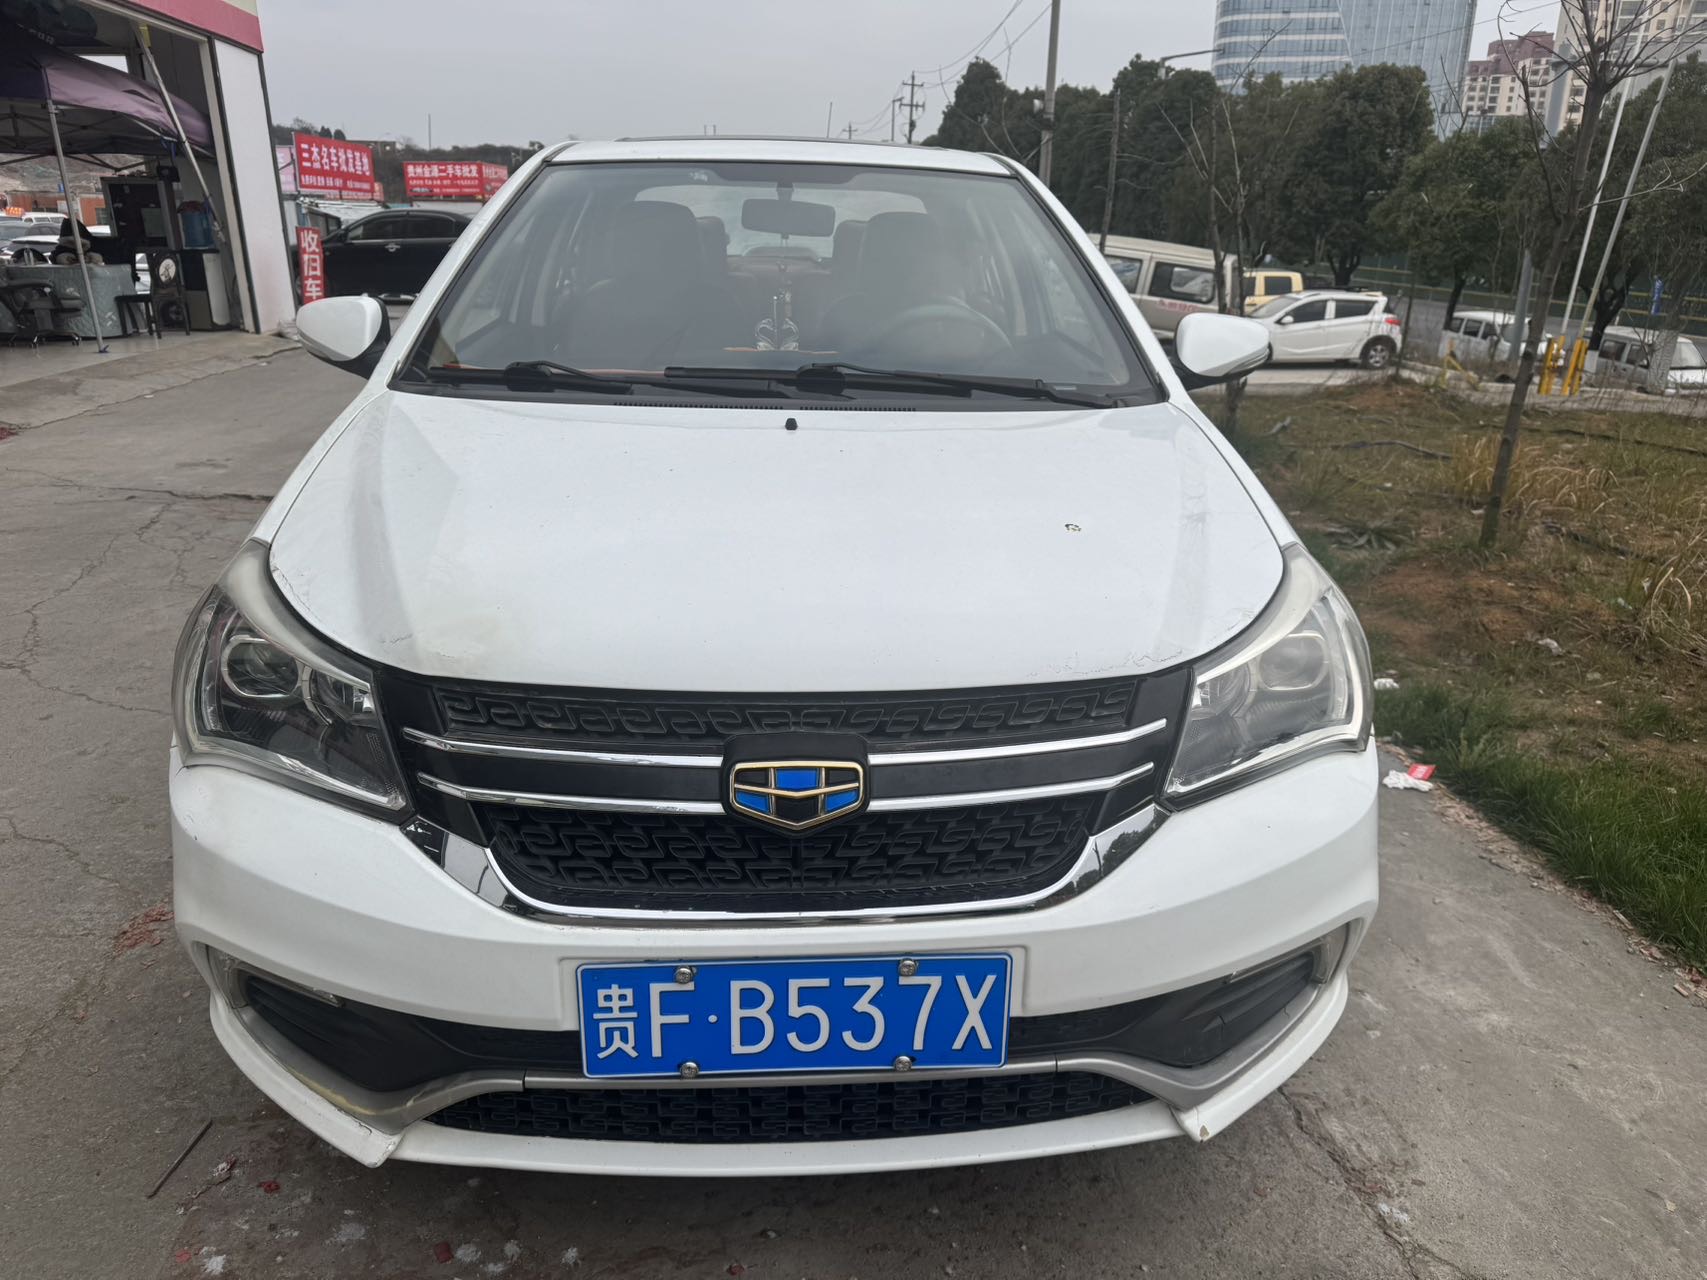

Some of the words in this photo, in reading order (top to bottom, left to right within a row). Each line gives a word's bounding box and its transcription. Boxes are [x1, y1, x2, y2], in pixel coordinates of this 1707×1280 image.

[302, 230, 323, 300] 收旧车
[592, 974, 998, 1060] 贵F·B537X
